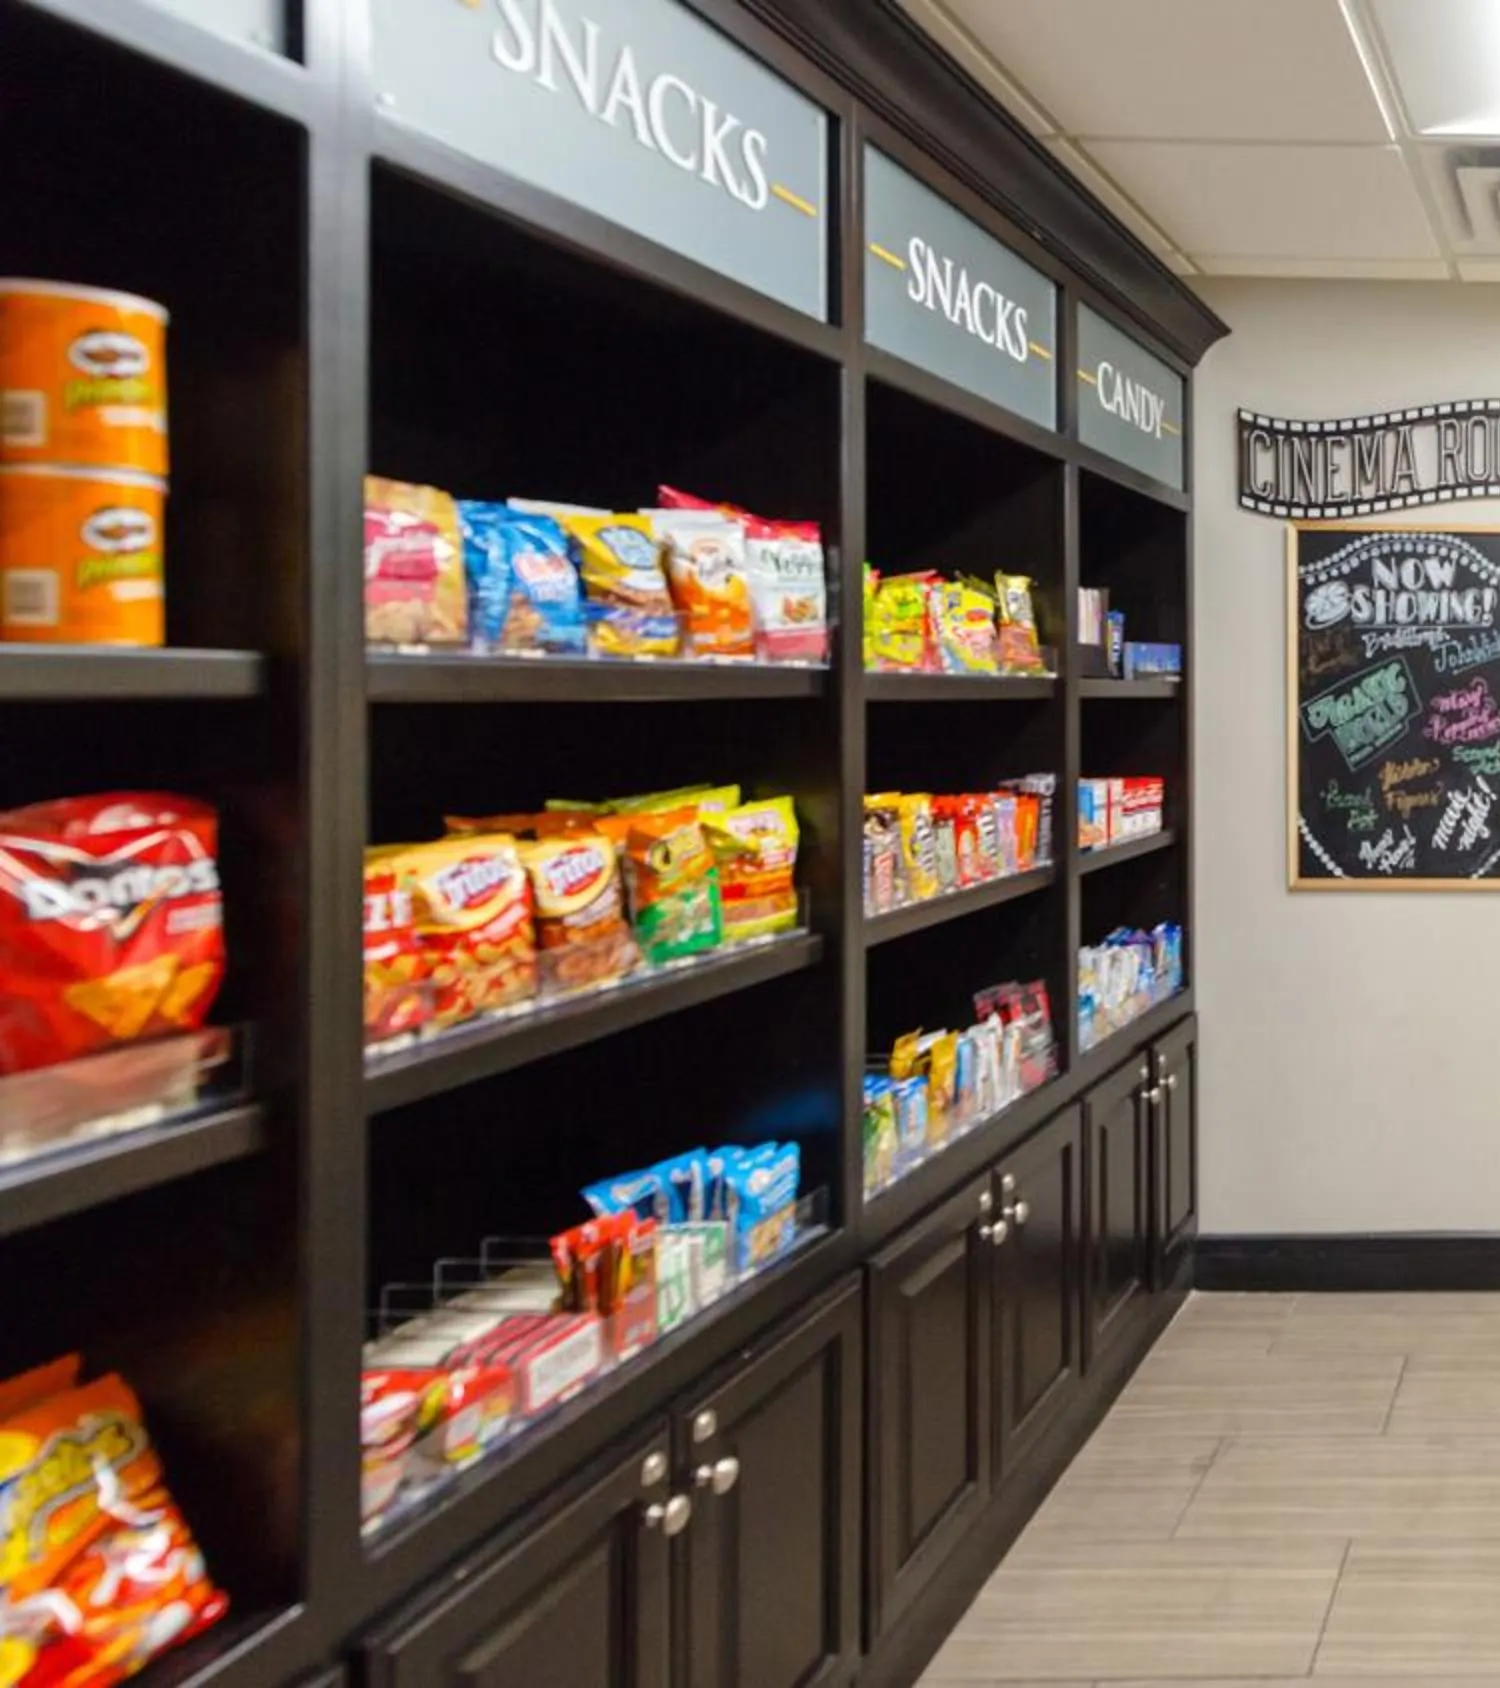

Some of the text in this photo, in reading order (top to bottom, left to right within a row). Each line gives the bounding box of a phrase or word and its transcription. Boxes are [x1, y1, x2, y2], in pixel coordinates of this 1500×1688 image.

[494, 0, 768, 210] SNACKS
[908, 237, 1029, 363] SNACKS
[1097, 361, 1164, 438] CANDY
[1247, 425, 1421, 502] CINEMA
[1350, 585, 1497, 625] SHOWING!
[1371, 556, 1457, 590] NOW
